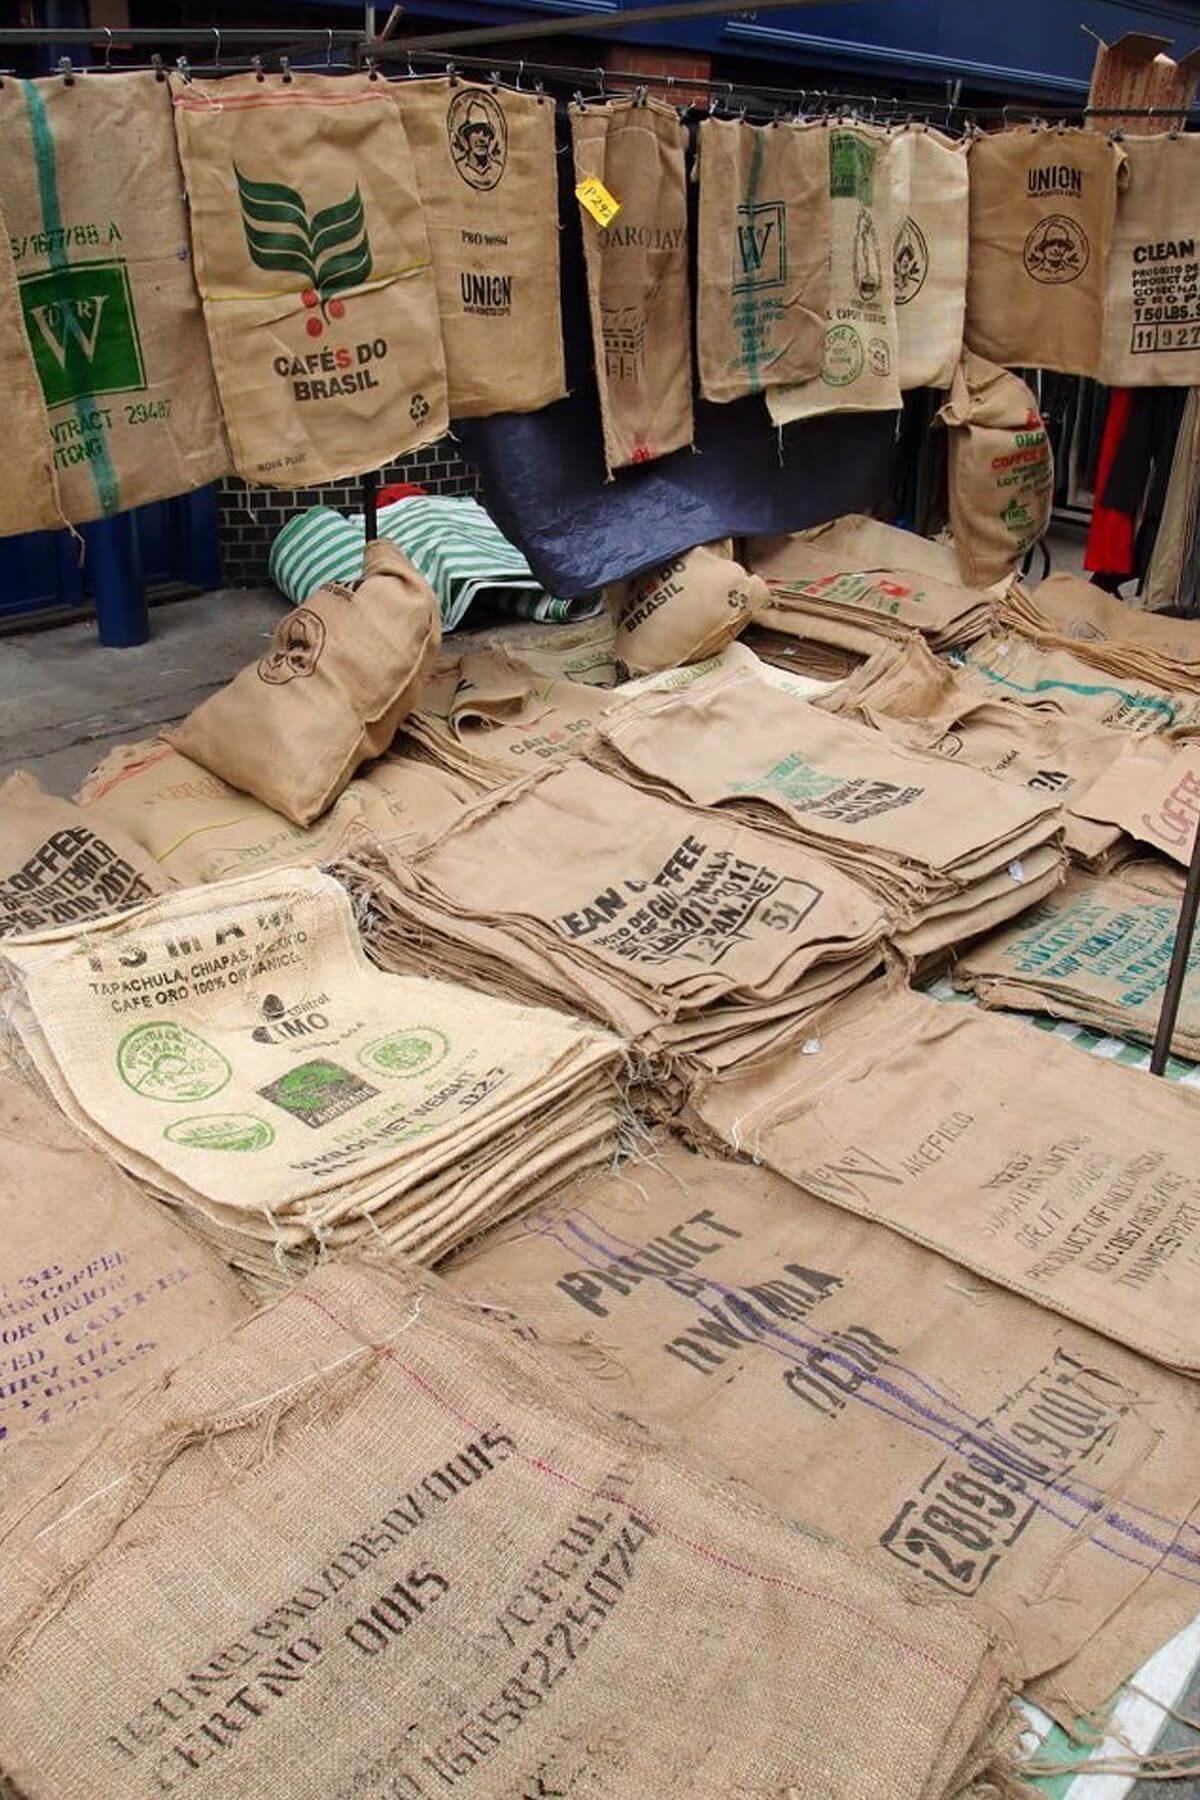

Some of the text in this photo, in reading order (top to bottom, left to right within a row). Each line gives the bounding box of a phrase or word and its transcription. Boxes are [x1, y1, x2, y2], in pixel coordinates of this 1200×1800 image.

[1028, 165, 1082, 192] UNION
[1133, 239, 1195, 264] CLEAN
[461, 273, 511, 305] UNION
[273, 338, 387, 377] CAFÉS DO
[293, 369, 379, 401] BRASIL
[660, 560, 687, 582] DO
[625, 582, 684, 632] BRASIL
[155, 986, 189, 1007] ORO
